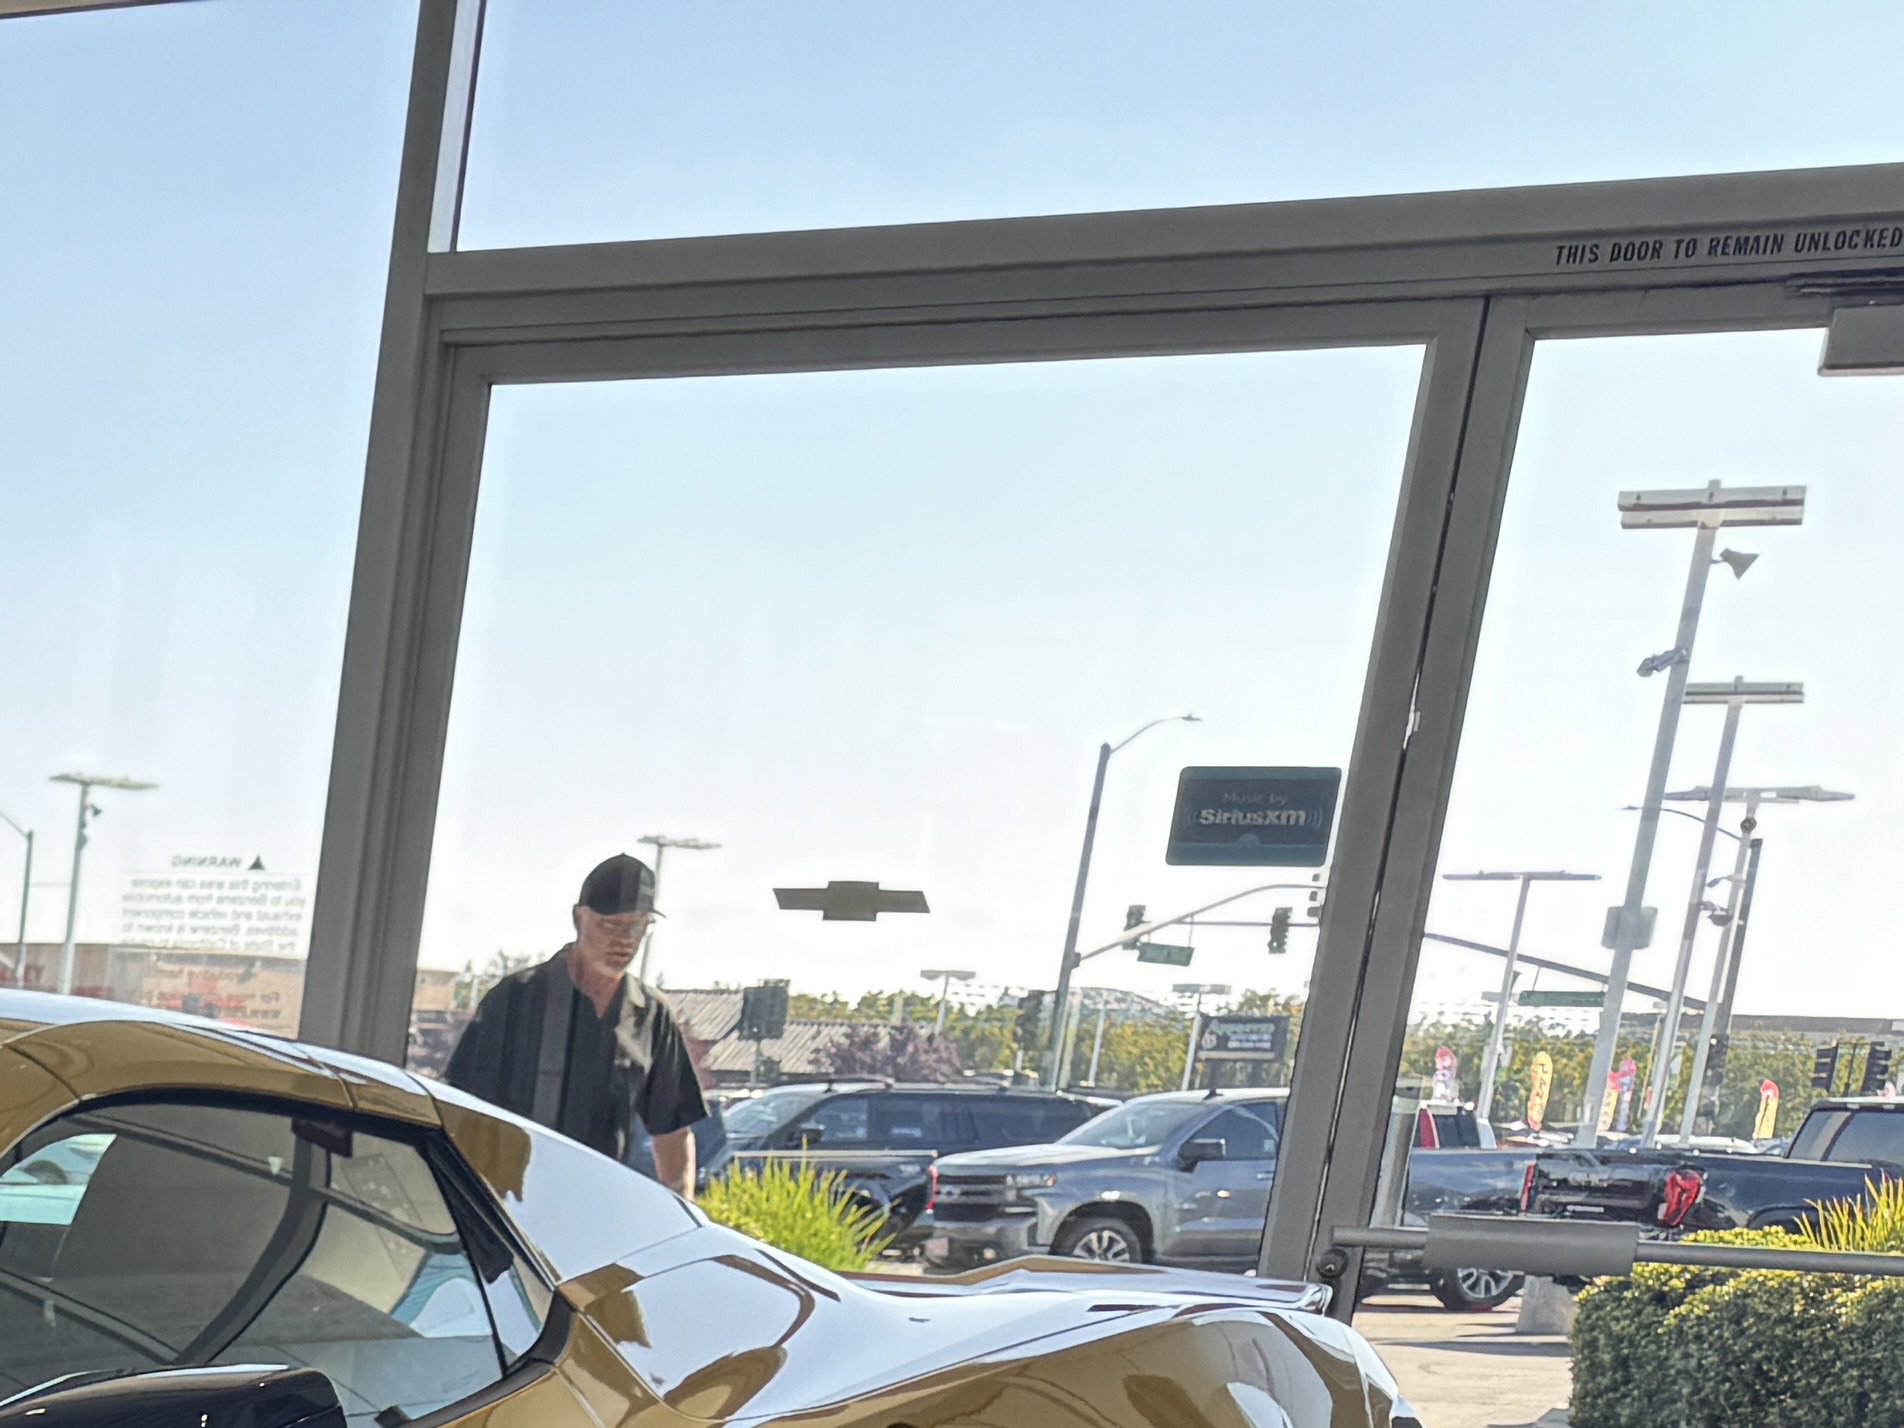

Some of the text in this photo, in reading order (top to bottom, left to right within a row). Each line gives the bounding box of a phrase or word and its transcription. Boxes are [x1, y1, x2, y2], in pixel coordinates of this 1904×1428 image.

[1555, 226, 1903, 266] THIS DOOR TO REMAIN UNLOCKED
